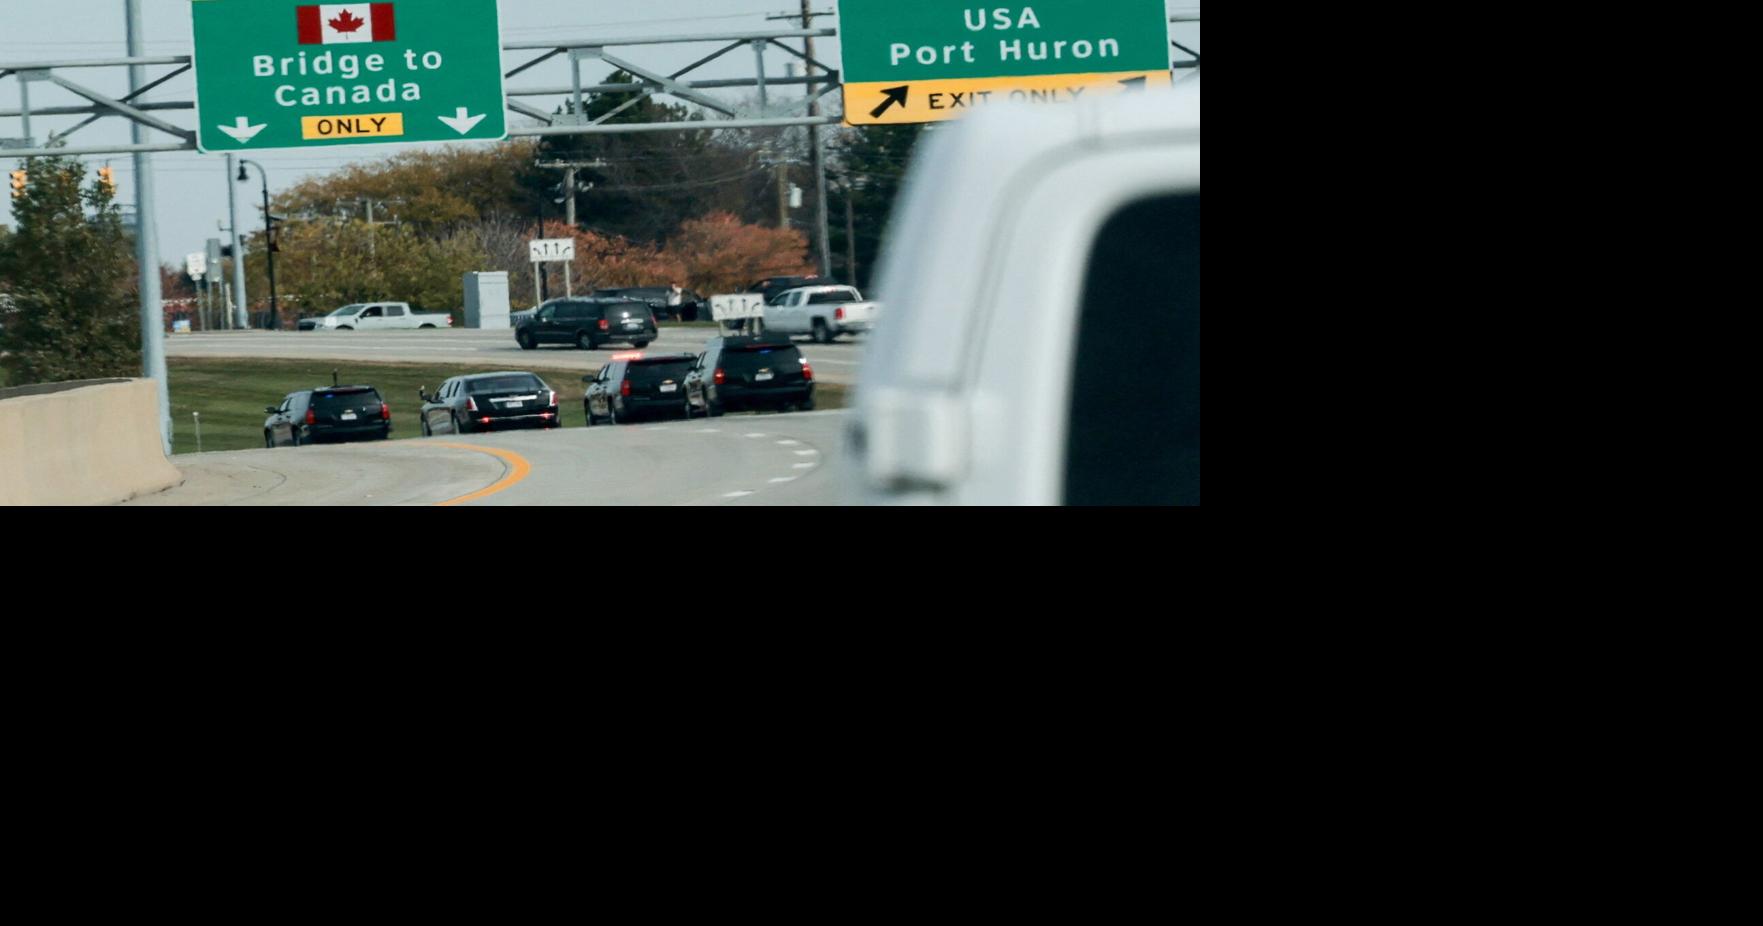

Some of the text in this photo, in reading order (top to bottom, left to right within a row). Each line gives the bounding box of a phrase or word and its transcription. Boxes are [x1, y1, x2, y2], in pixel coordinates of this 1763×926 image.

[964, 7, 1040, 31] USA
[253, 49, 442, 79] Bridge to
[890, 38, 1119, 66] Port Huron
[274, 78, 422, 107] Canada
[928, 86, 1085, 110] EXIT ONLY
[317, 117, 387, 135] ONLY
